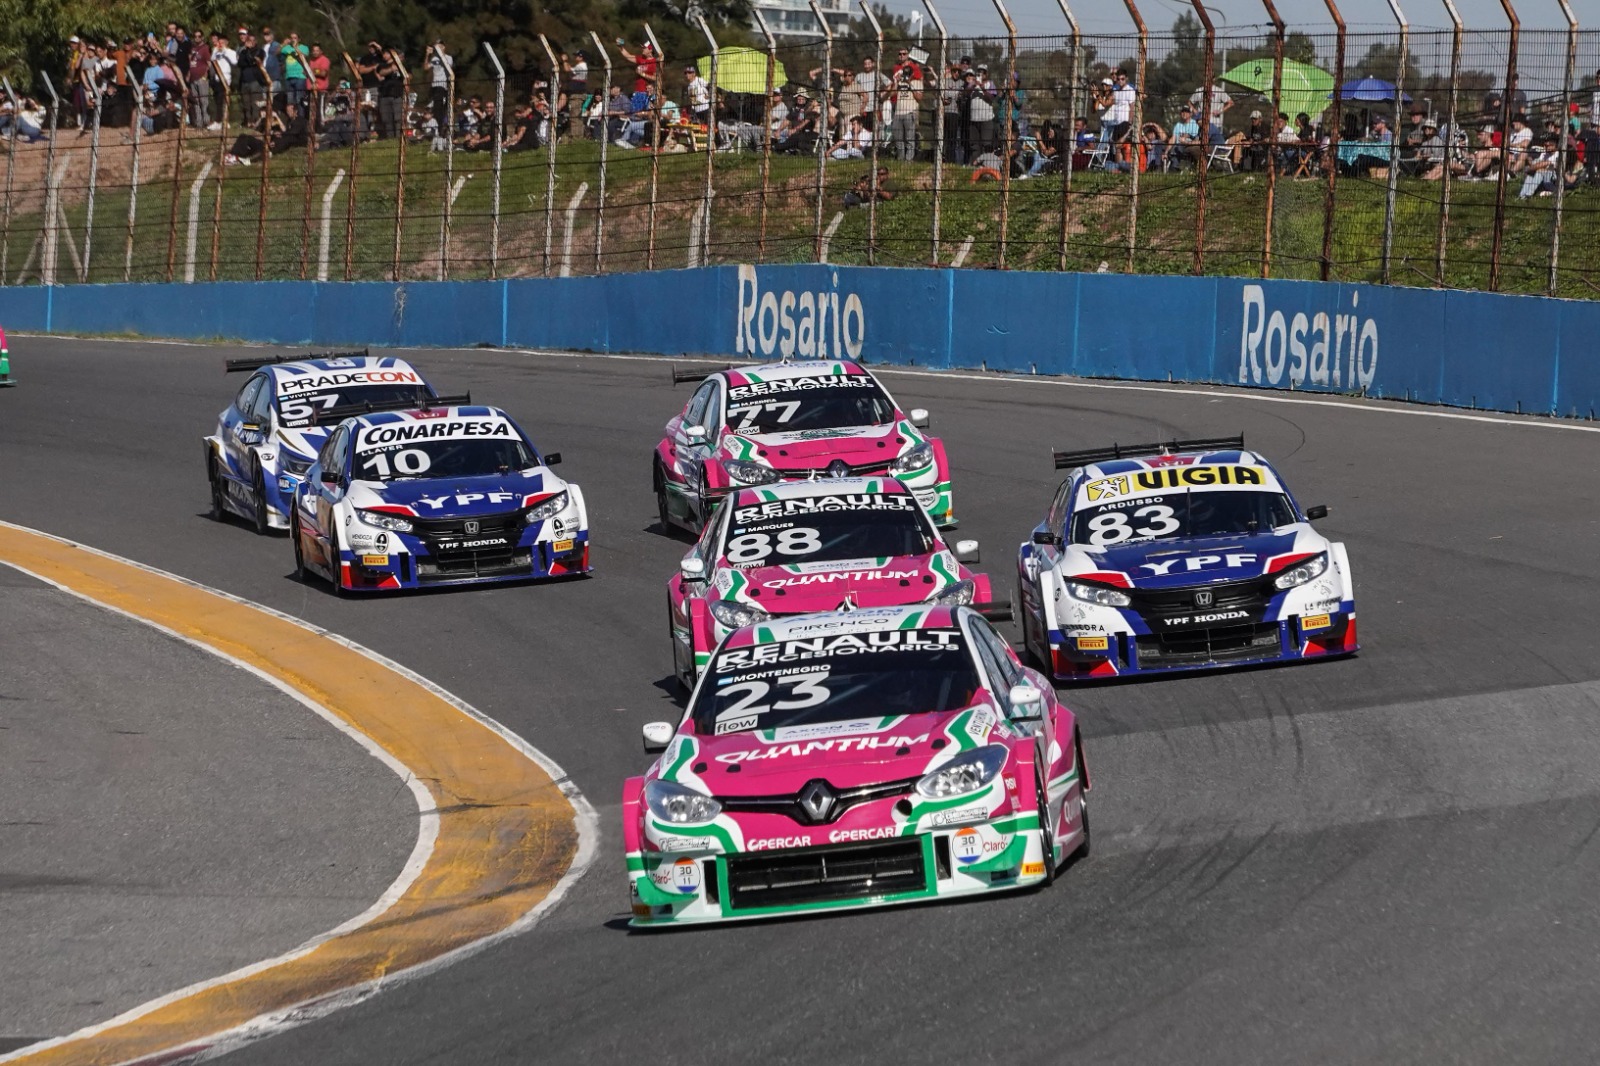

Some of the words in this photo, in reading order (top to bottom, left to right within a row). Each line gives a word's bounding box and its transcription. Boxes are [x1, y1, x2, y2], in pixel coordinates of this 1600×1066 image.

[736, 264, 864, 359] Rosario
[1239, 285, 1378, 391] Rosario
[281, 371, 417, 392] PRADECON
[728, 375, 871, 398] RENAULT
[289, 391, 318, 399] VIVIAN
[731, 383, 875, 400] CONCESIONARIOS
[280, 394, 339, 420] 57
[727, 401, 801, 430] 77
[364, 422, 510, 445] CONARPESA
[361, 445, 404, 457] LLAVER
[362, 449, 432, 480] 10
[417, 492, 515, 510] YPF
[734, 494, 914, 521] RENAULT
[1098, 497, 1164, 513] ARDUSSO
[736, 505, 915, 525] CONCESIONARIOS
[747, 522, 794, 533] MARQUES
[1088, 505, 1181, 546] 83
[438, 542, 459, 550] YPF
[462, 537, 508, 548] HONDA
[727, 527, 823, 563] 88
[1140, 553, 1258, 576] YPF
[762, 570, 919, 589] QUANTIUM
[788, 618, 889, 633] PIRENCO
[1164, 618, 1190, 626] YPF
[1195, 611, 1249, 623] HONDA
[716, 630, 961, 669] RENAULT
[1079, 639, 1105, 648] PIRELLI
[716, 643, 960, 674] CONCESIONARIOS
[734, 664, 832, 683] MONTENEGRO
[715, 671, 831, 722] 23
[716, 717, 757, 732] flow
[715, 733, 930, 764] QUANTIUM
[962, 836, 975, 845] 30
[983, 841, 1005, 852] Claro
[965, 847, 974, 855] 11
[680, 866, 692, 875] 30
[683, 877, 691, 885] 11
